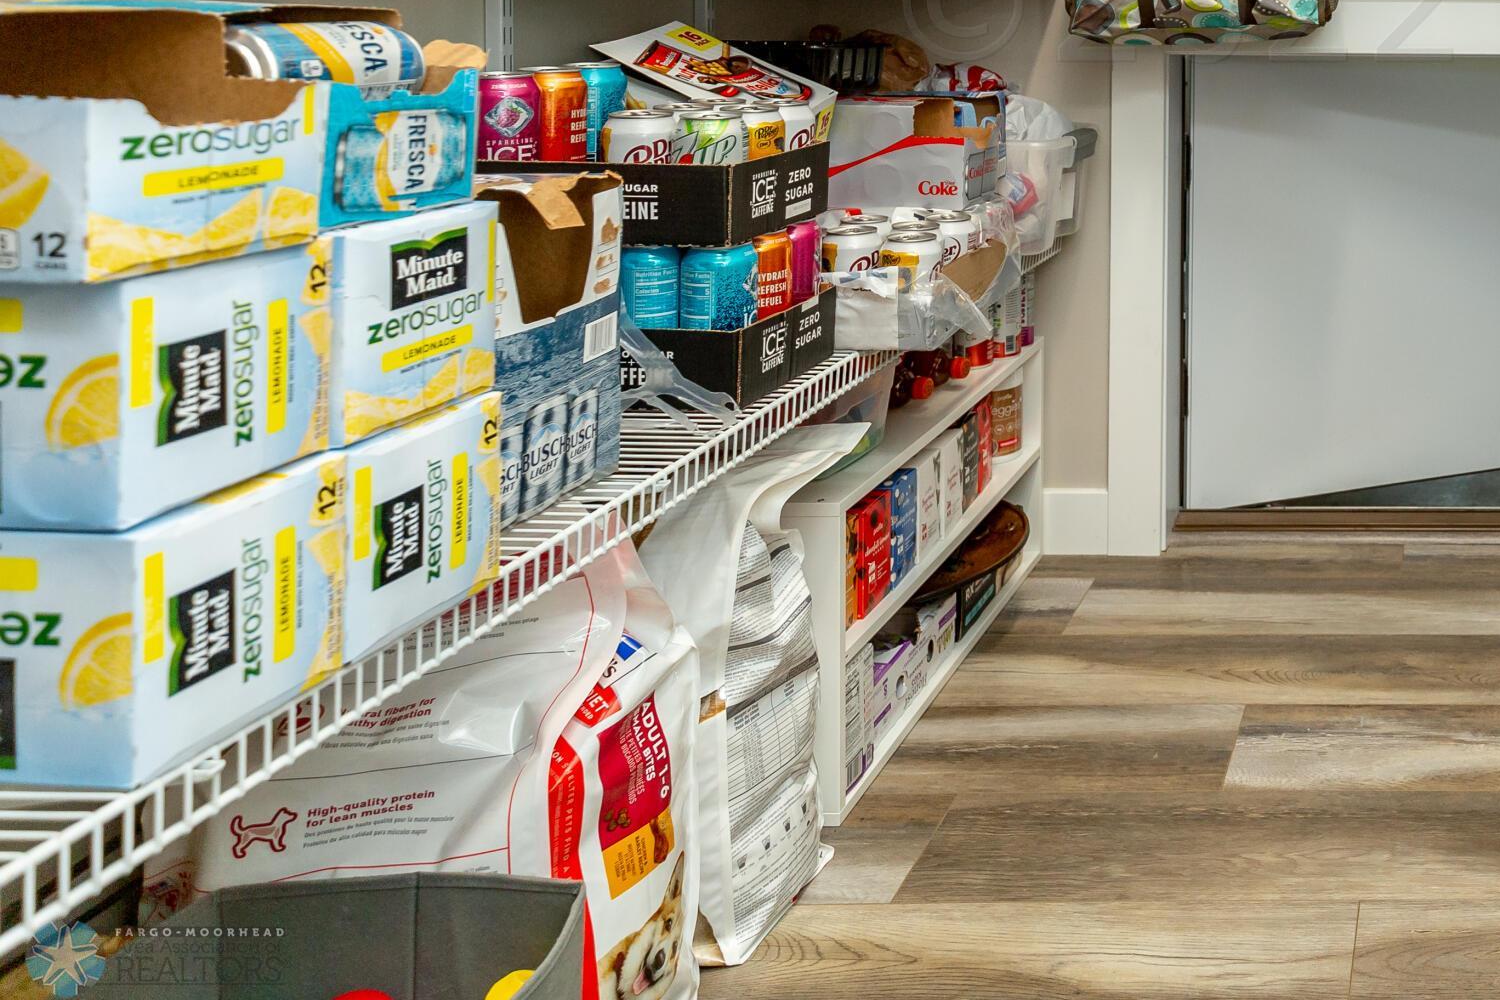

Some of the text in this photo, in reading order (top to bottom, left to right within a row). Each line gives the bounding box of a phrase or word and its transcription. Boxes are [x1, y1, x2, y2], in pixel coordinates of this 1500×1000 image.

[404, 115, 428, 192] FRESCA
[486, 137, 533, 147] SPARKLING
[486, 144, 534, 162] ICE
[178, 165, 260, 188] LEMONADE
[788, 167, 812, 184] ZERO
[918, 181, 958, 196] Coke
[752, 176, 776, 204] ICE
[785, 182, 814, 202] SUGAR
[623, 201, 659, 220] EINE
[752, 204, 774, 219] CAFFEINE
[32, 232, 66, 258] 12
[396, 249, 464, 279] Minute
[310, 264, 327, 293] 12
[406, 267, 457, 298] Maid
[799, 311, 820, 331] ZERO
[403, 335, 456, 361] LEMONADE
[762, 328, 787, 358] ICE
[795, 327, 822, 349] SUGAR
[273, 328, 282, 404] LEMONADE
[762, 352, 784, 373] CAFFEINE
[175, 344, 200, 433] Minute
[199, 348, 222, 415] Maid
[992, 401, 1018, 417] eggie
[484, 418, 499, 446] 12
[565, 423, 598, 451] BUSCH
[523, 431, 569, 473] BUSCH
[570, 440, 592, 462] LIGHT
[500, 461, 523, 487] SCH
[530, 459, 559, 480] LIGHT
[318, 480, 337, 516] 12
[455, 478, 464, 544] LEMONADE
[387, 501, 405, 578] Minute
[404, 502, 419, 556] Maid
[280, 556, 291, 633] LEMONADE
[185, 589, 210, 682] Minute
[208, 590, 230, 657] Maid
[380, 708, 432, 727] digestion
[384, 697, 437, 716] fibers for
[641, 701, 670, 799] ADULT 1-6
[642, 747, 656, 782] BITES
[306, 803, 414, 829] for lean muscles
[307, 790, 435, 818] High-quality protein
